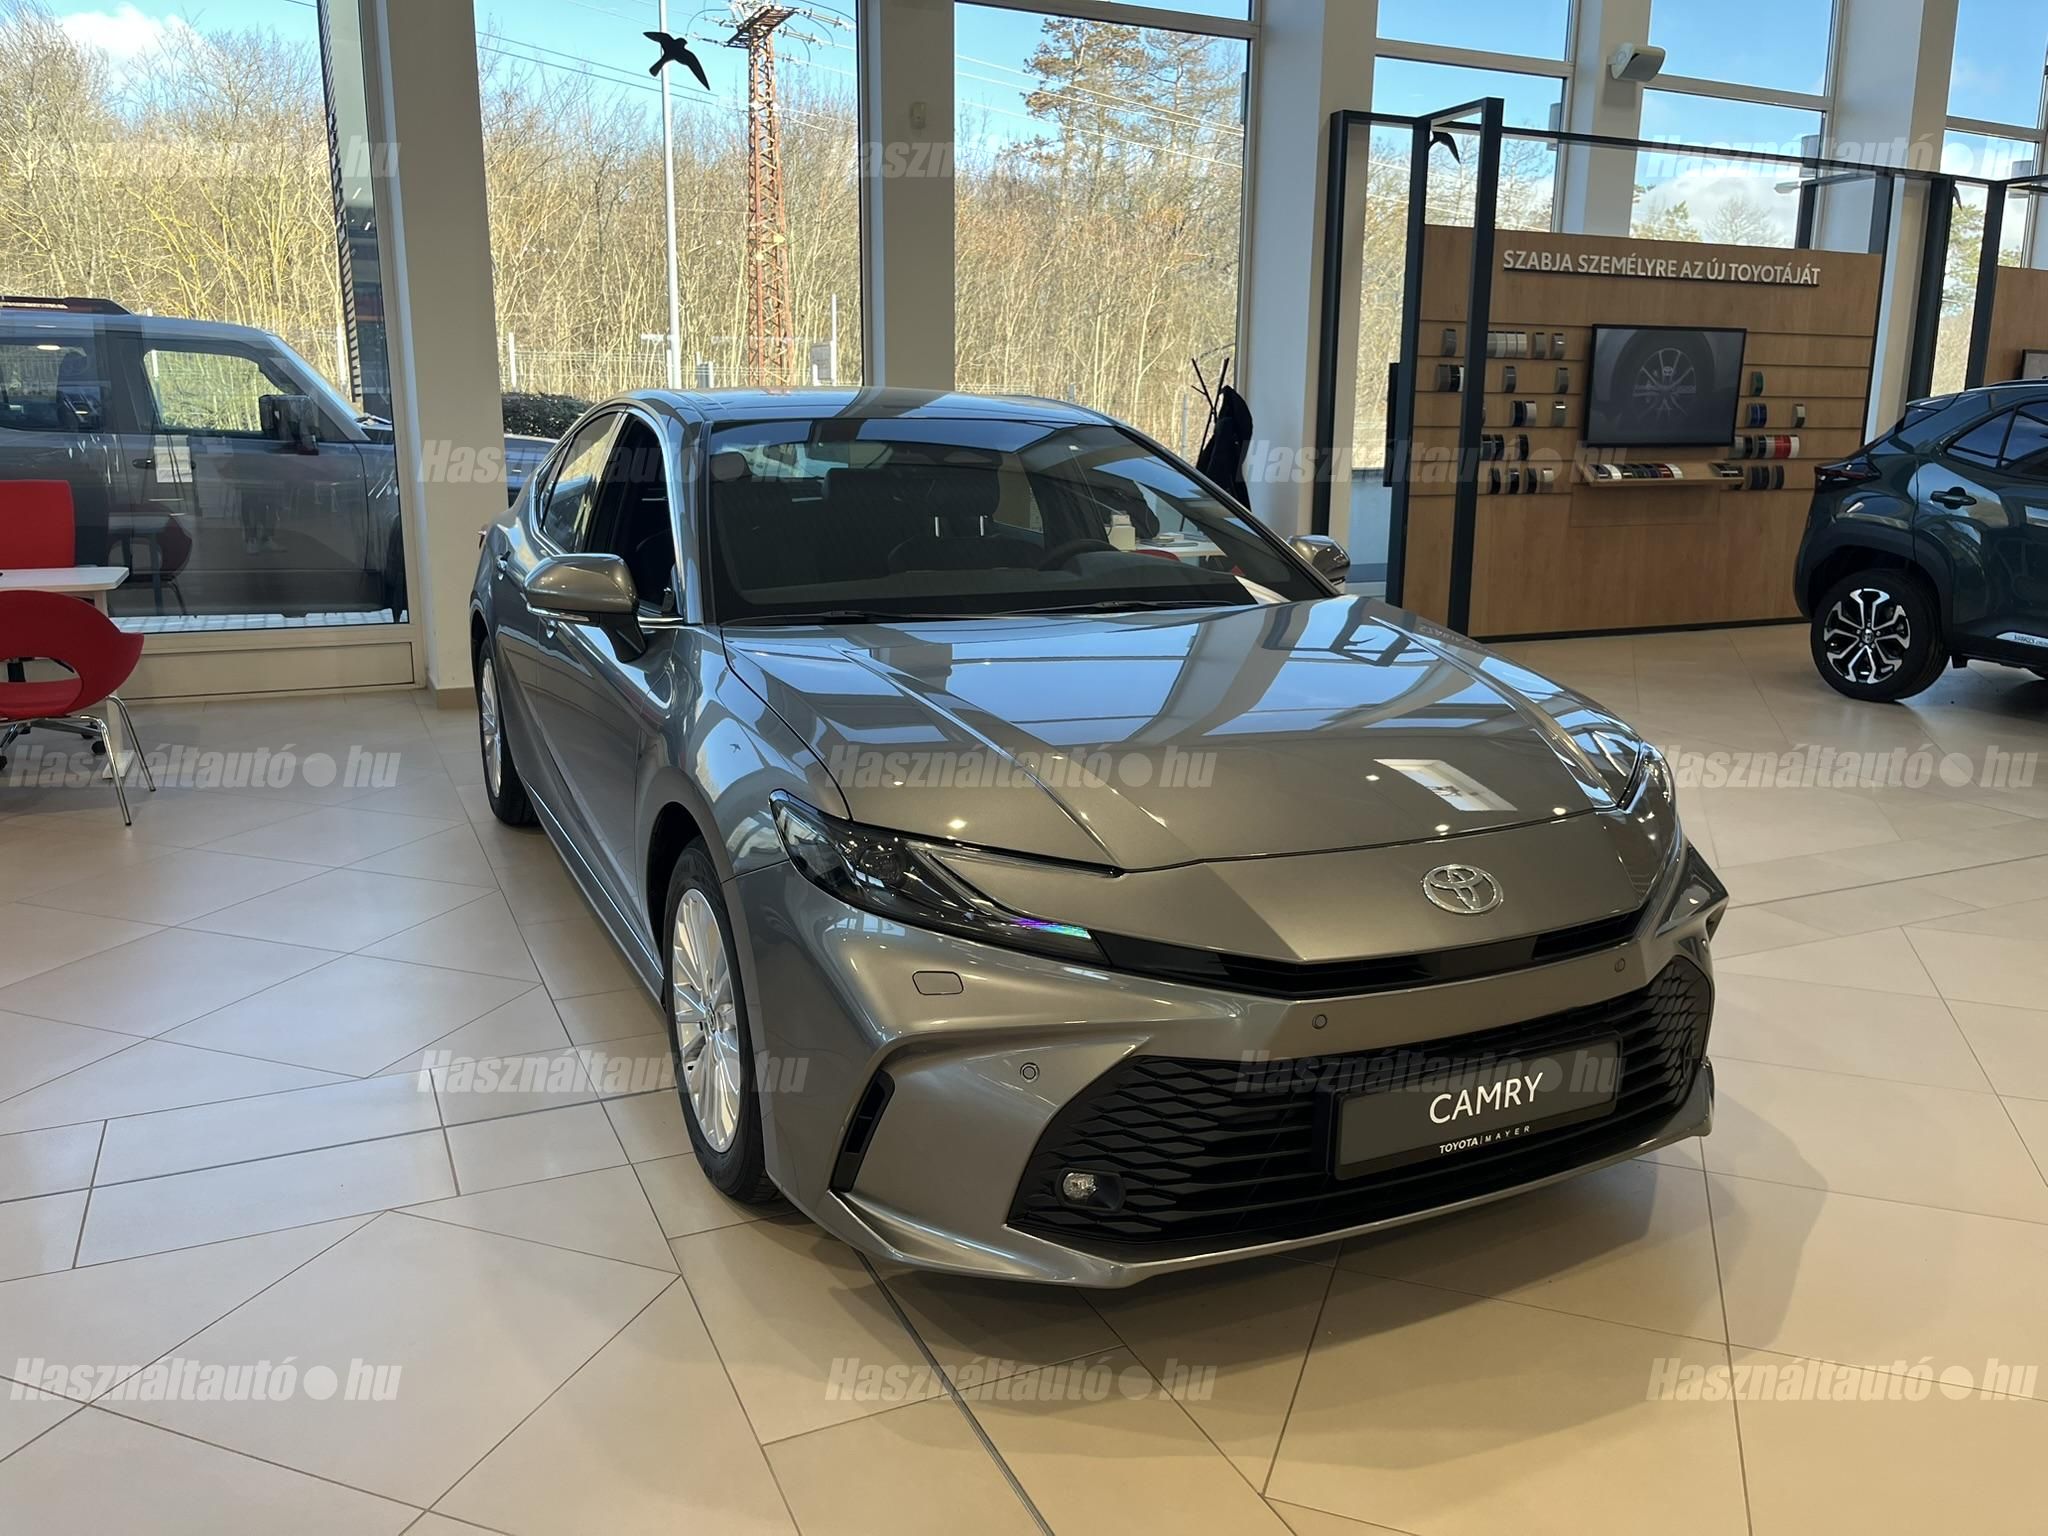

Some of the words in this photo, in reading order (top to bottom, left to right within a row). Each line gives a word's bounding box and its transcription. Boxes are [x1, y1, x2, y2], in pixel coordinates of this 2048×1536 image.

[1503, 249, 1573, 272] SZABJA
[1577, 253, 1678, 278] SZEMÉLYRE
[1680, 260, 1703, 280] AZ
[1706, 258, 1725, 281] ÚJ
[1729, 262, 1821, 285] TOYOTÁJÁT
[1429, 1072, 1544, 1124] CAMRY
[1439, 1137, 1479, 1154] TOYOTA
[1485, 1125, 1531, 1143] MAYER
